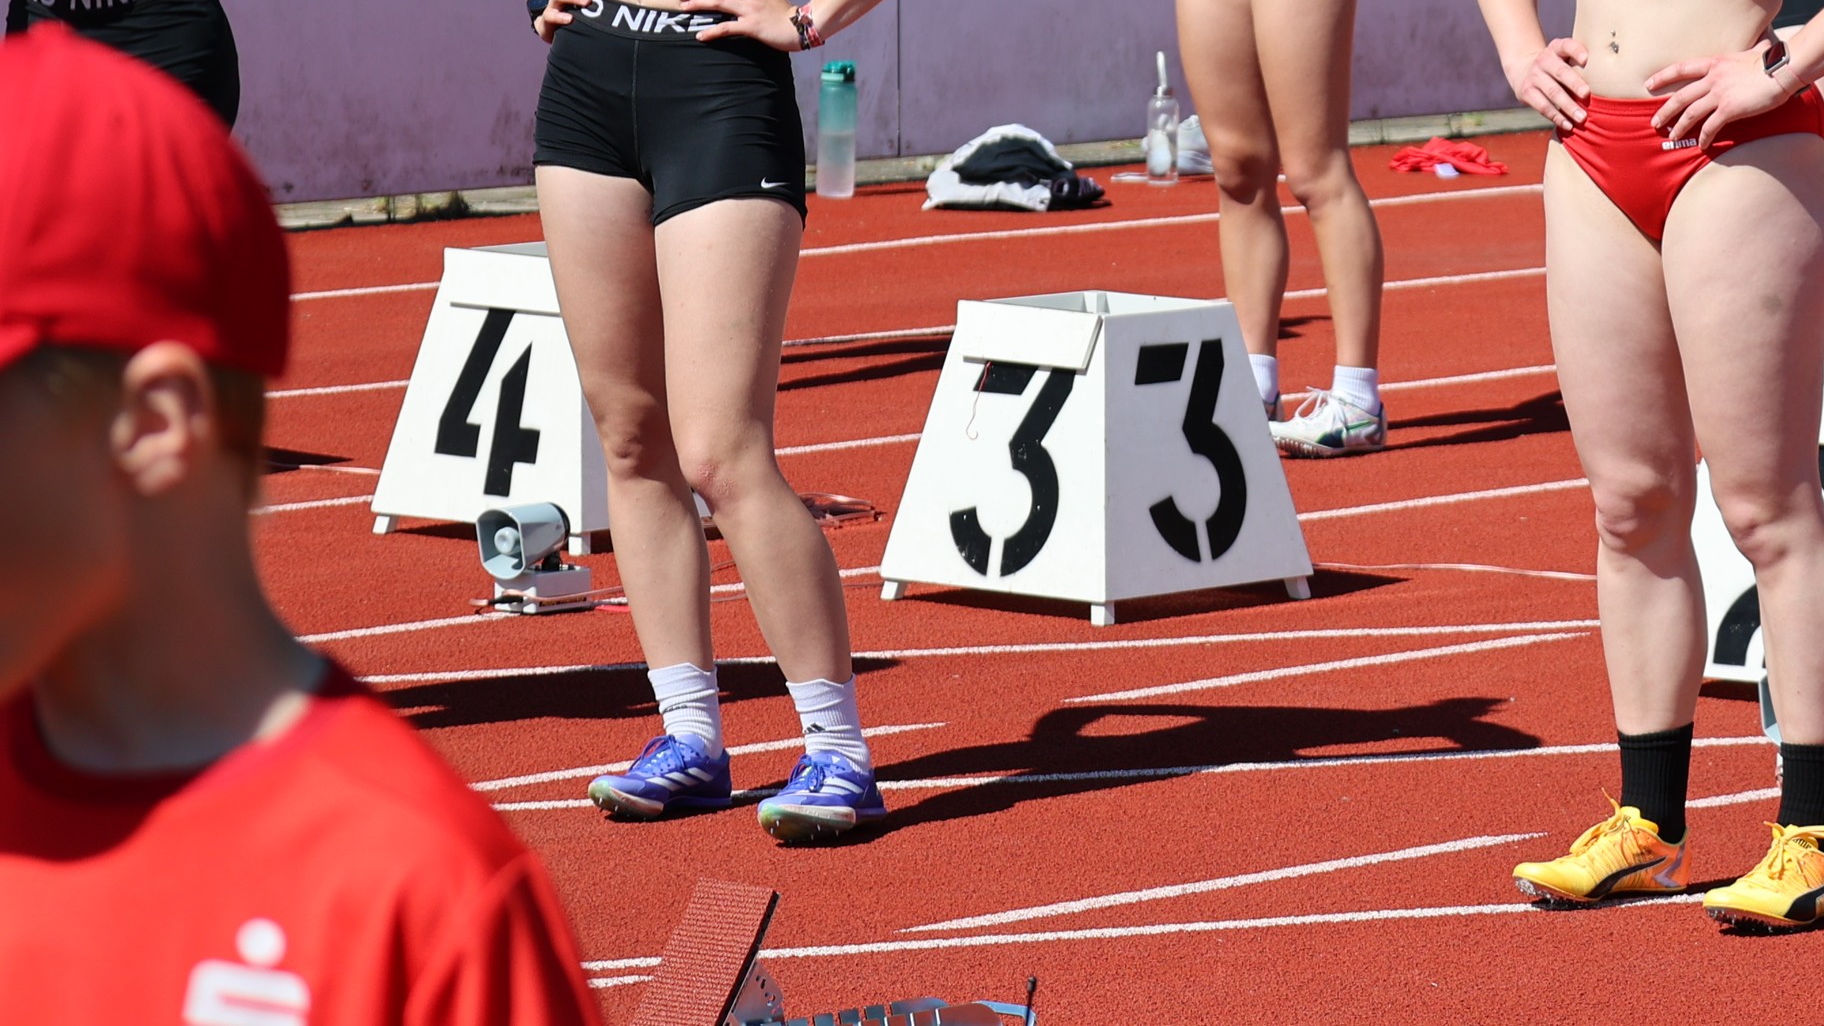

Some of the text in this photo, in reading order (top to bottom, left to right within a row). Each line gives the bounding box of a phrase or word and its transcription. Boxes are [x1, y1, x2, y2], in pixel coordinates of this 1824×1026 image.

[611, 5, 718, 33] NIKE
[434, 307, 541, 498] 4
[949, 360, 1076, 577] 3
[1134, 338, 1247, 563] 3
